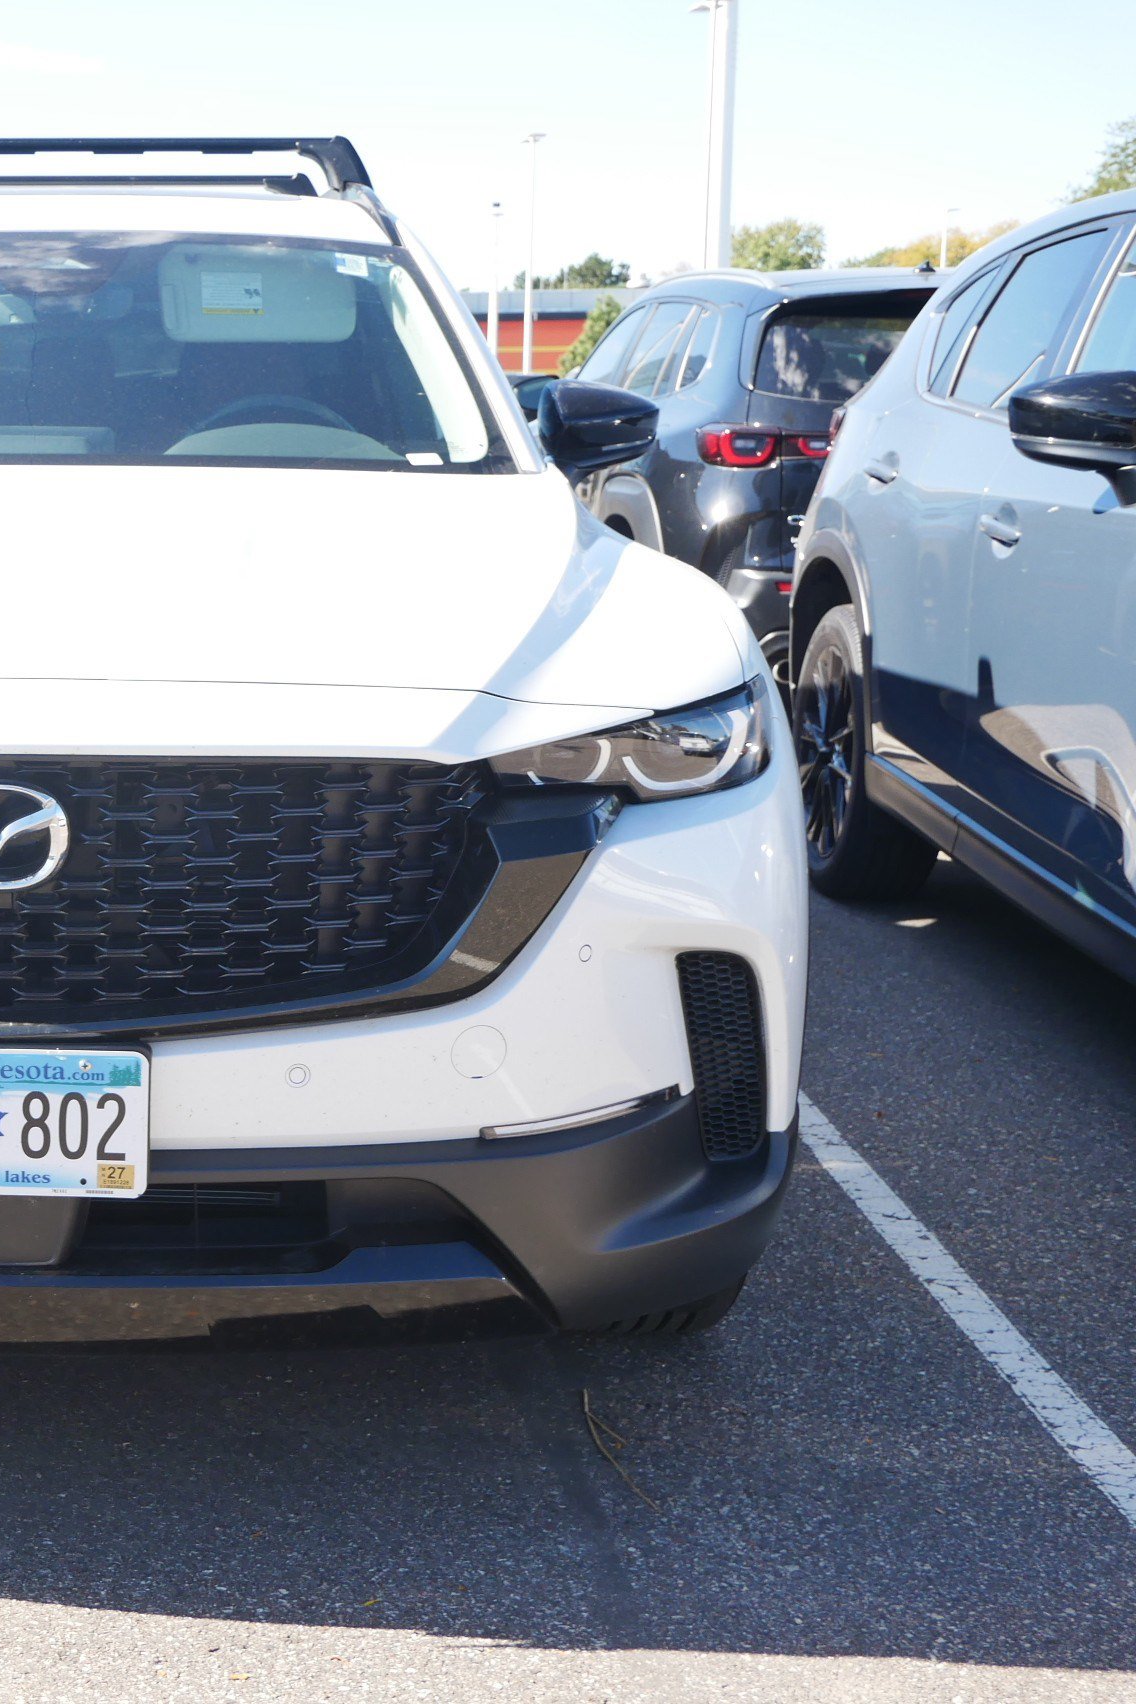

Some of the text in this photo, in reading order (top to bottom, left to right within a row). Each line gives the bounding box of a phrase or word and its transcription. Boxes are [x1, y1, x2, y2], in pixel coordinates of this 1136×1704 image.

[20, 1090, 127, 1162] 802
[4, 1170, 51, 1184] lakes
[107, 1166, 126, 1180] 27
